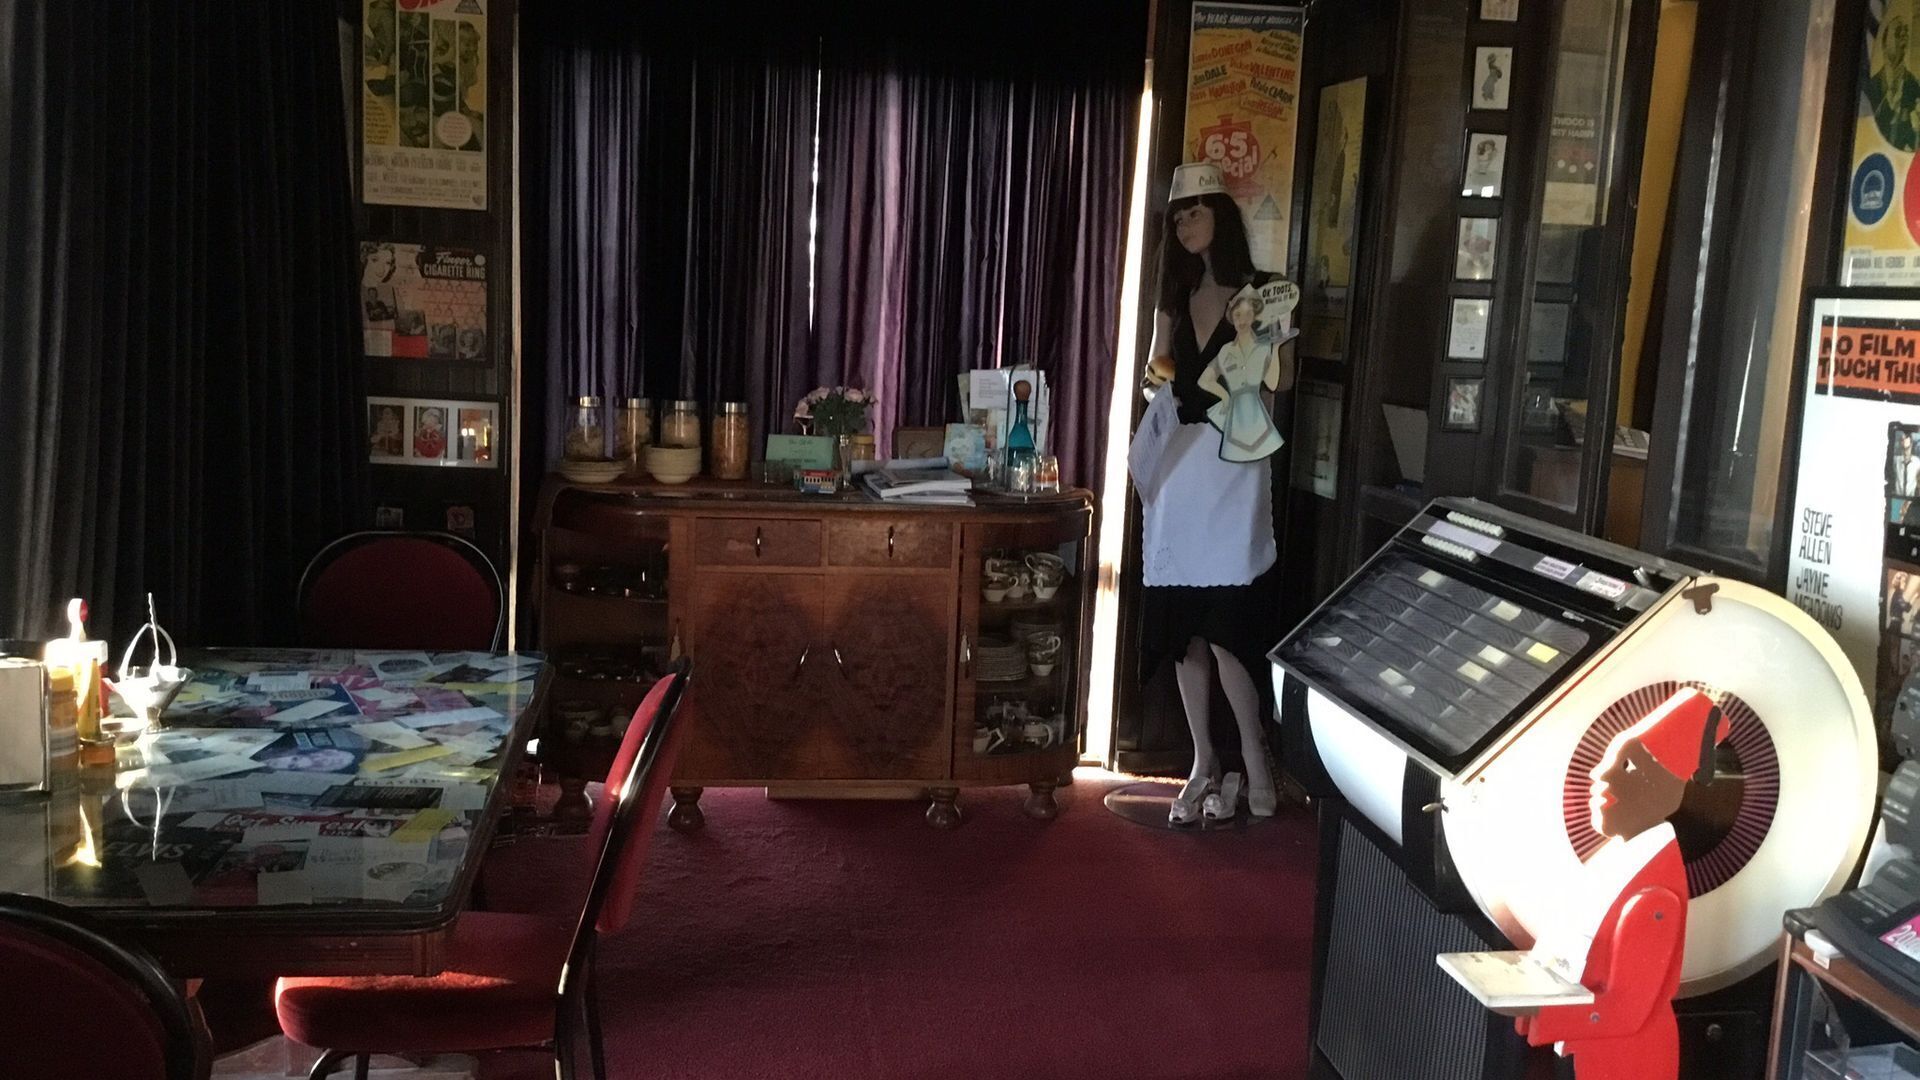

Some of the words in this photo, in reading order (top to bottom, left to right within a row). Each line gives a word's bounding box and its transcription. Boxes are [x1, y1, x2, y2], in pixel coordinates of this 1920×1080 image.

[1204, 64, 1228, 80] DALE
[1249, 61, 1296, 81] VALENTINE
[1268, 85, 1295, 104] CLARK
[1204, 144, 1258, 178] ecial
[424, 263, 464, 278] CIGARETTE
[465, 265, 486, 280] RING
[1262, 288, 1274, 298] OK
[1822, 335, 1853, 355] NO
[1859, 333, 1915, 358] FILM
[1817, 357, 1881, 382] TOUCH
[1802, 507, 1833, 539] STEVE
[1799, 535, 1833, 565] ALLEN
[1796, 567, 1830, 598] JAYNE
